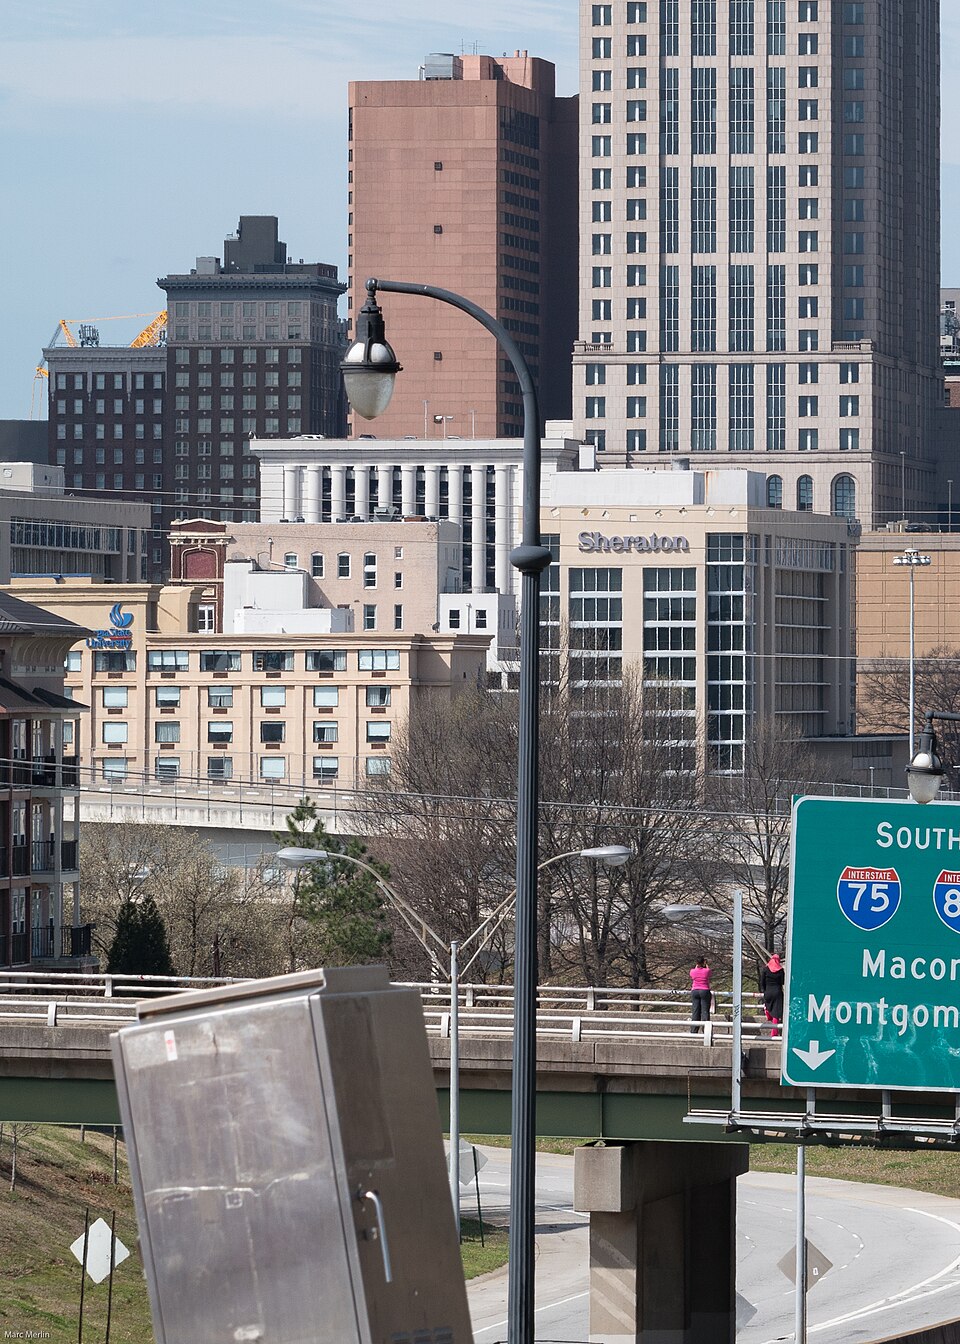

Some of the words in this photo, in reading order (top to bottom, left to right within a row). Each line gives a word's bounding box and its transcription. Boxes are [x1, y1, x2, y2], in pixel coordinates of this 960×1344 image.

[578, 531, 690, 554] Sheraton
[86, 639, 131, 650] University
[848, 870, 891, 881] INTERSTATE
[848, 882, 890, 913] 75
